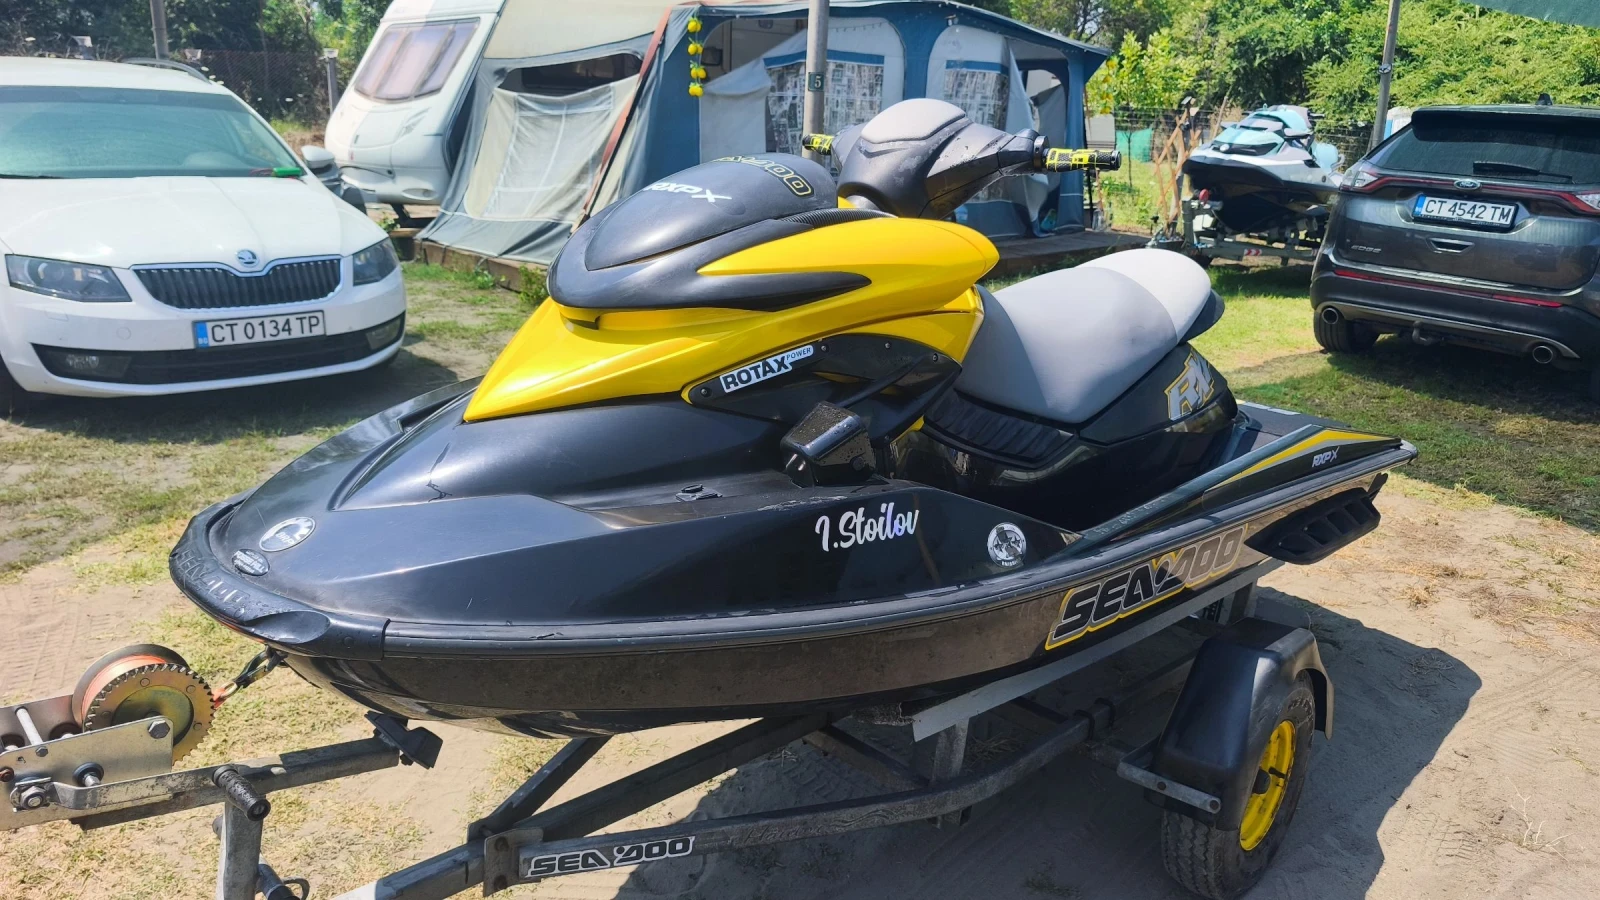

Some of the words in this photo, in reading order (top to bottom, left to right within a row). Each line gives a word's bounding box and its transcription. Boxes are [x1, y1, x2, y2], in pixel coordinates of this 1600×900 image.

[814, 75, 822, 88] 5
[1425, 199, 1447, 214] CT
[1448, 201, 1487, 219] 4542
[1489, 206, 1512, 223] TM
[211, 323, 238, 343] CT
[243, 318, 292, 340] 0134
[295, 315, 320, 335] TP
[721, 355, 790, 390] ROTAX
[786, 347, 811, 361] POWER
